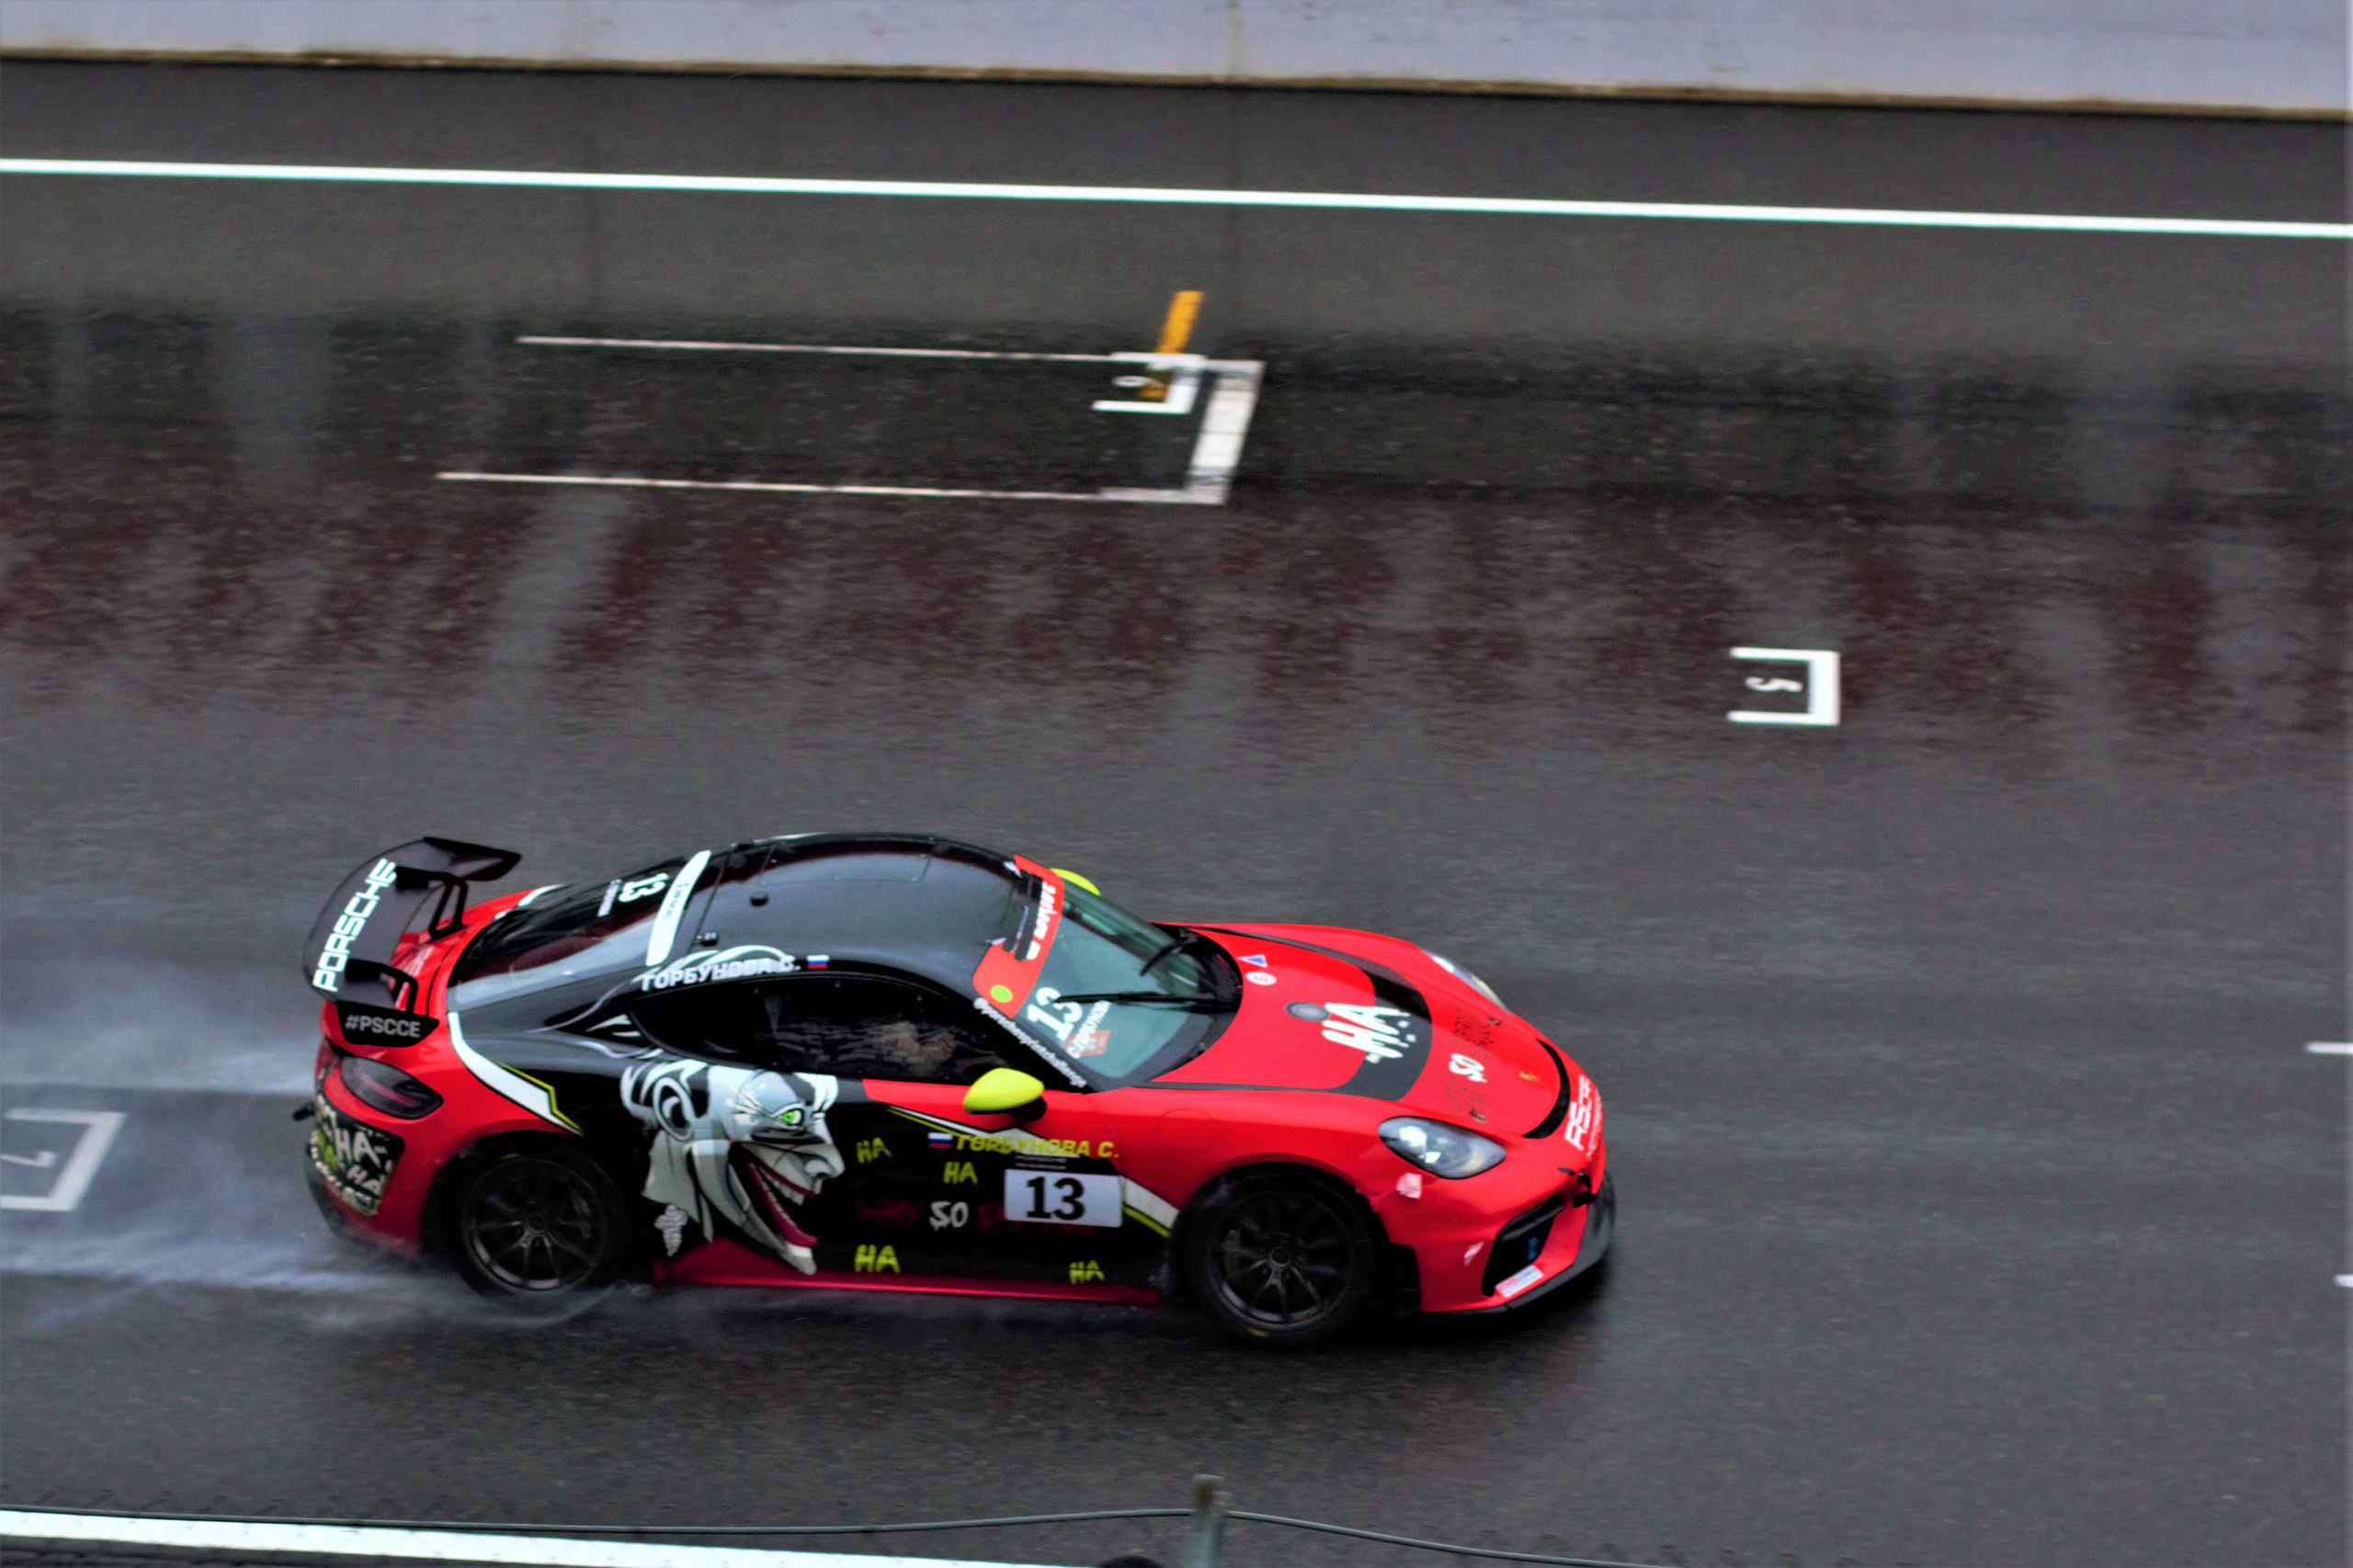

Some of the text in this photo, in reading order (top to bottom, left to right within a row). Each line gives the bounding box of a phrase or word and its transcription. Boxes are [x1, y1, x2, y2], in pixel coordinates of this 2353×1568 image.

[620, 872, 669, 903] 13
[313, 858, 397, 992] PORSCHE
[345, 1014, 422, 1038] #PSCCE
[1027, 986, 1083, 1040] 13
[856, 1136, 892, 1164] HA
[943, 1161, 978, 1185] HA
[1026, 1176, 1086, 1221] 13
[928, 1200, 969, 1231] SO
[854, 1244, 901, 1273] HA
[1069, 1260, 1105, 1284] HA
